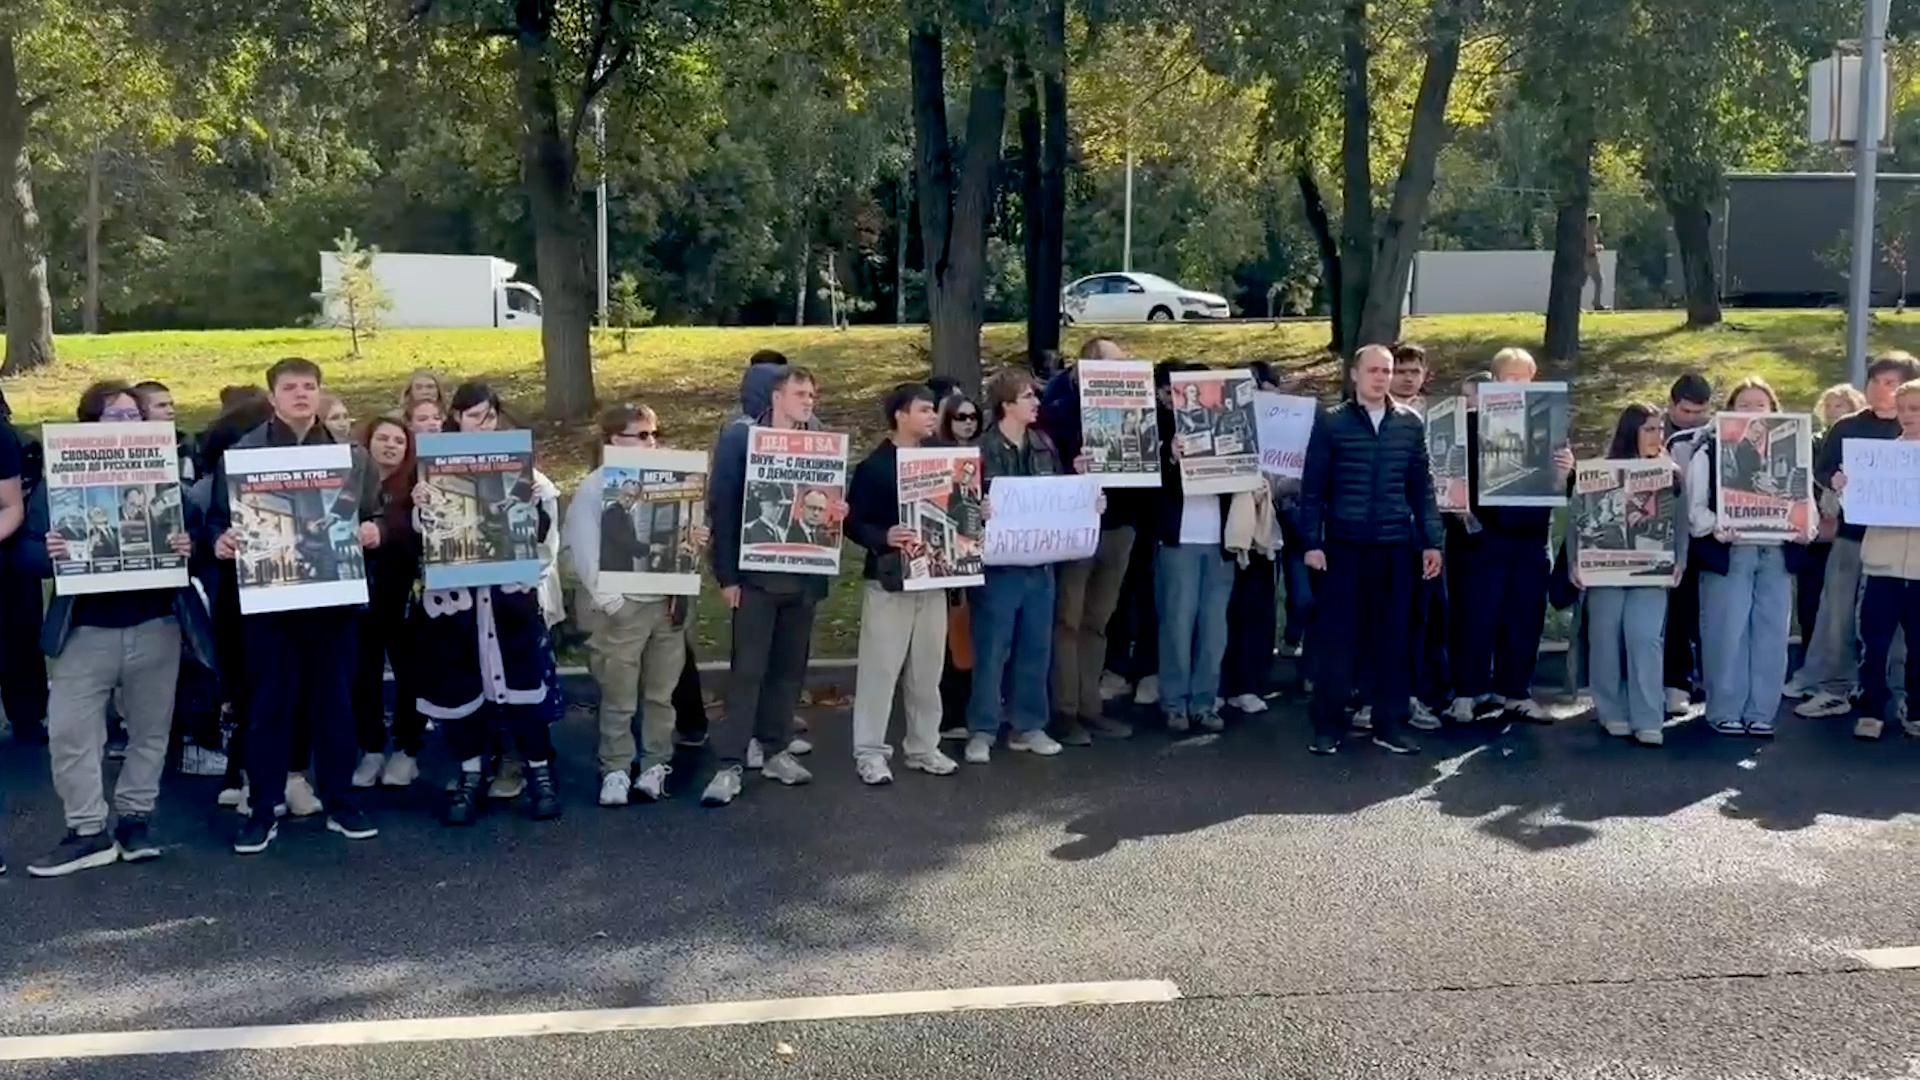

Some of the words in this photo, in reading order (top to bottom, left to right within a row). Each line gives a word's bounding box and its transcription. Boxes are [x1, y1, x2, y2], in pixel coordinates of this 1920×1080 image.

[760, 434, 788, 452] ДЕД
[61, 448, 126, 461] СВОБОДОЮ
[750, 453, 775, 466] ВНУК
[786, 457, 794, 468] С
[795, 457, 844, 471] ЛЕКЦИЯМИ
[103, 460, 142, 471] РУССКИХ
[757, 468, 765, 479] О
[766, 468, 836, 484] ДЕМОКРАТИИ?
[1724, 505, 1788, 519] ЧЕЛОВЕК?
